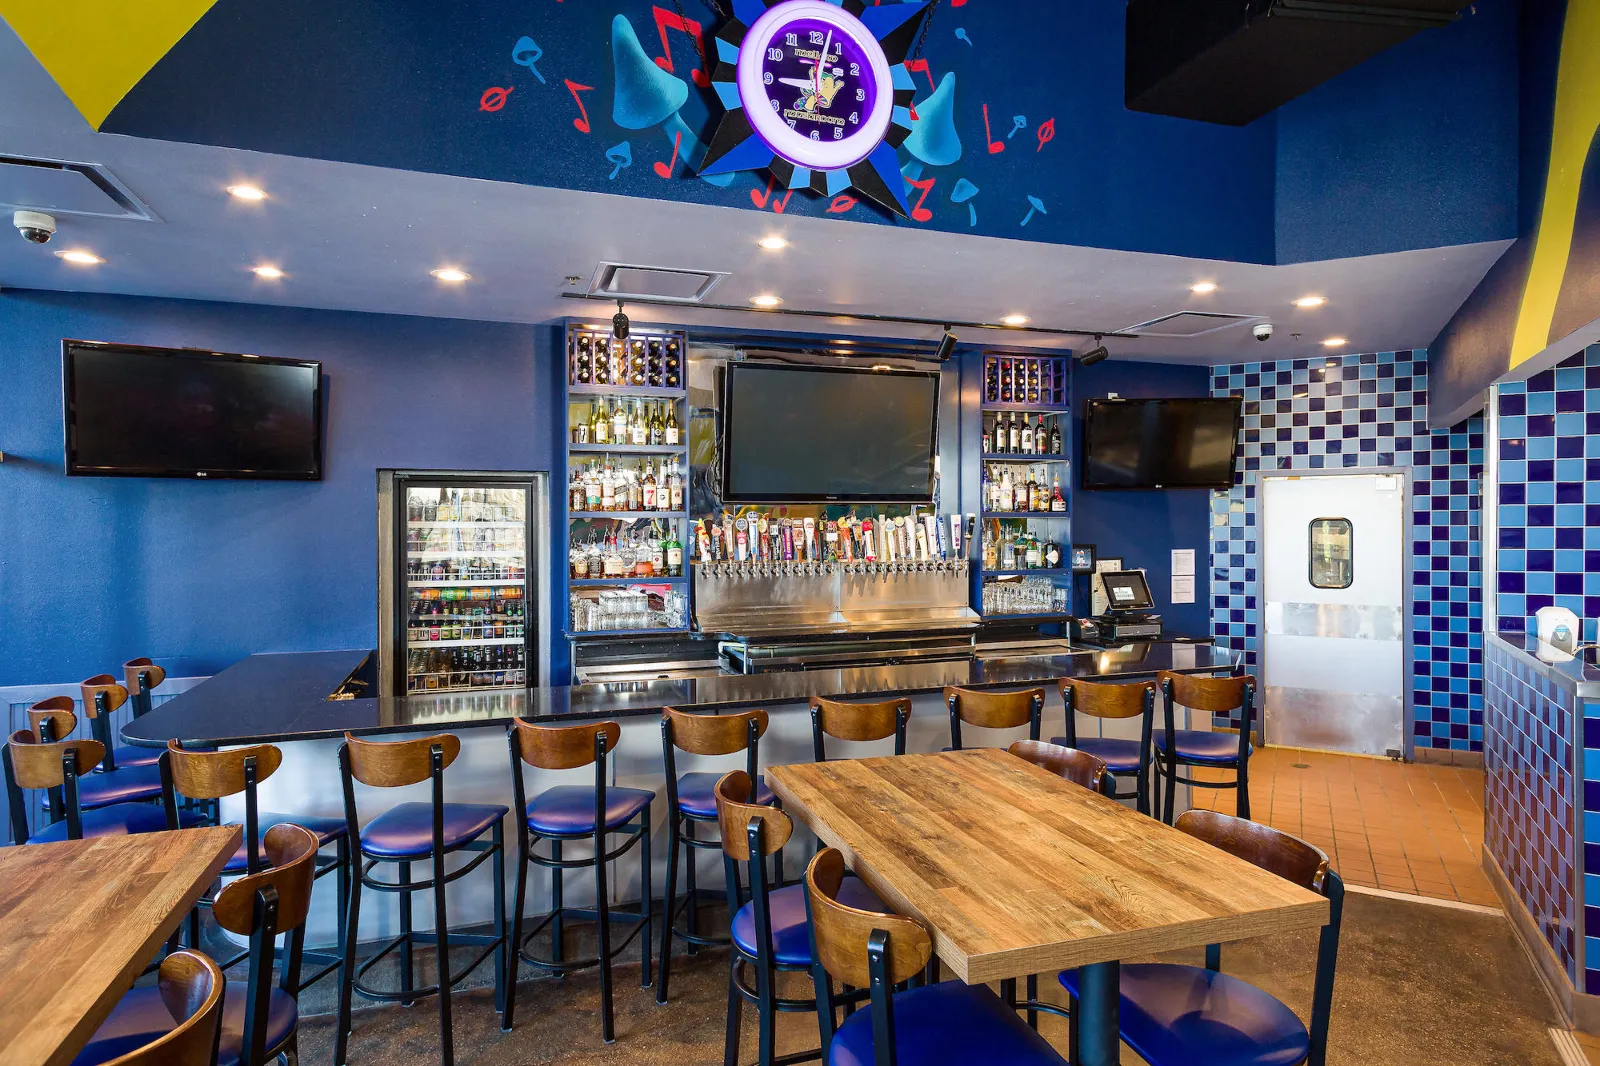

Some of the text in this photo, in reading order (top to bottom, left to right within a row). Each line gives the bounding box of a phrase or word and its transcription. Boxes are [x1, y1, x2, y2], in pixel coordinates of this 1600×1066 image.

[786, 33, 798, 46] 11
[809, 31, 823, 45] 12
[768, 48, 783, 61] 10
[835, 42, 842, 55] 1
[850, 63, 859, 76] 2
[763, 72, 773, 85] 9
[856, 88, 865, 101] 3
[770, 99, 779, 112] 8
[787, 119, 796, 130] 7
[849, 112, 859, 124] 4
[810, 130, 820, 141] 6
[834, 127, 843, 139] 5
